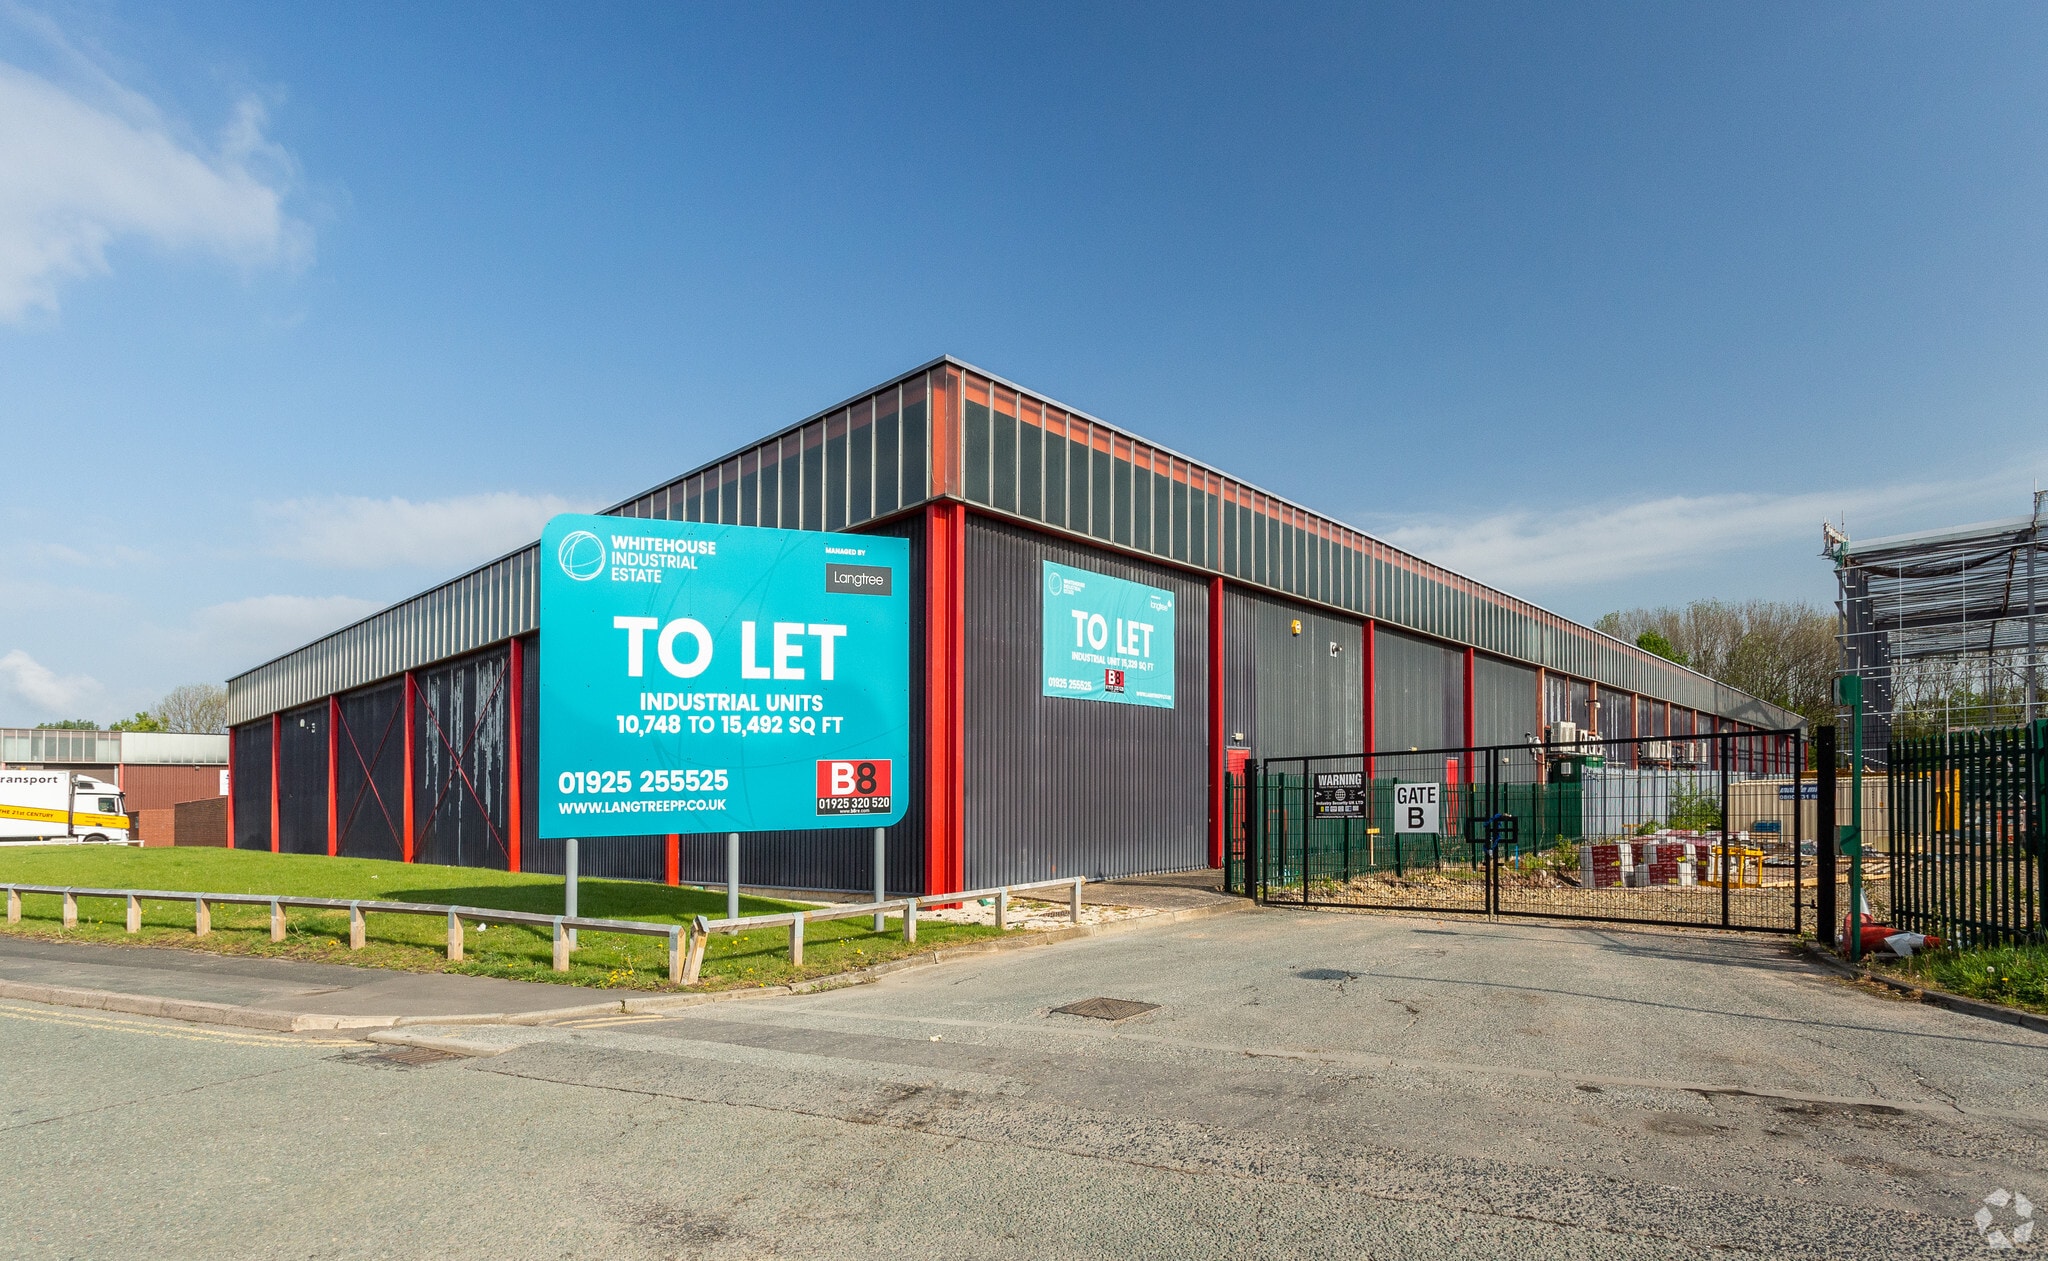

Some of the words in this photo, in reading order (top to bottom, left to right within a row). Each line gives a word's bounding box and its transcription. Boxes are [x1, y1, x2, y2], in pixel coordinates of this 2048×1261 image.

[611, 535, 716, 555] WHITEHOUSE
[825, 547, 857, 556] MANAGED
[611, 552, 698, 570] INDUSTRIAL
[611, 568, 662, 583] ESTATE
[834, 570, 884, 587] Langtree
[1071, 609, 1108, 651] TO
[1117, 618, 1154, 658] LET
[613, 616, 714, 679] TO
[741, 621, 847, 681] LET
[1071, 651, 1106, 666] INDUSTRIAL
[1107, 657, 1120, 667] UNIT
[1139, 661, 1147, 672] SQ
[1147, 663, 1154, 671] FT
[1108, 670, 1121, 685] B8
[640, 692, 760, 712] INDUSTRIAL
[766, 694, 823, 712] UNITS
[616, 714, 681, 738] 10,748
[687, 715, 715, 734] TO
[721, 716, 782, 737] 15,492
[788, 716, 816, 736] SQ
[822, 716, 844, 734] FT
[558, 770, 632, 794] 01925
[639, 769, 729, 793] 255525
[831, 762, 877, 795] B8
[1318, 773, 1362, 786] WARNING
[819, 798, 849, 809] 01925
[851, 798, 870, 809] 320
[872, 797, 890, 808] 520
[1397, 786, 1436, 805] GATE
[558, 799, 727, 815] WWW.LANGTREEPP.CO.UK
[1408, 807, 1425, 829] B
